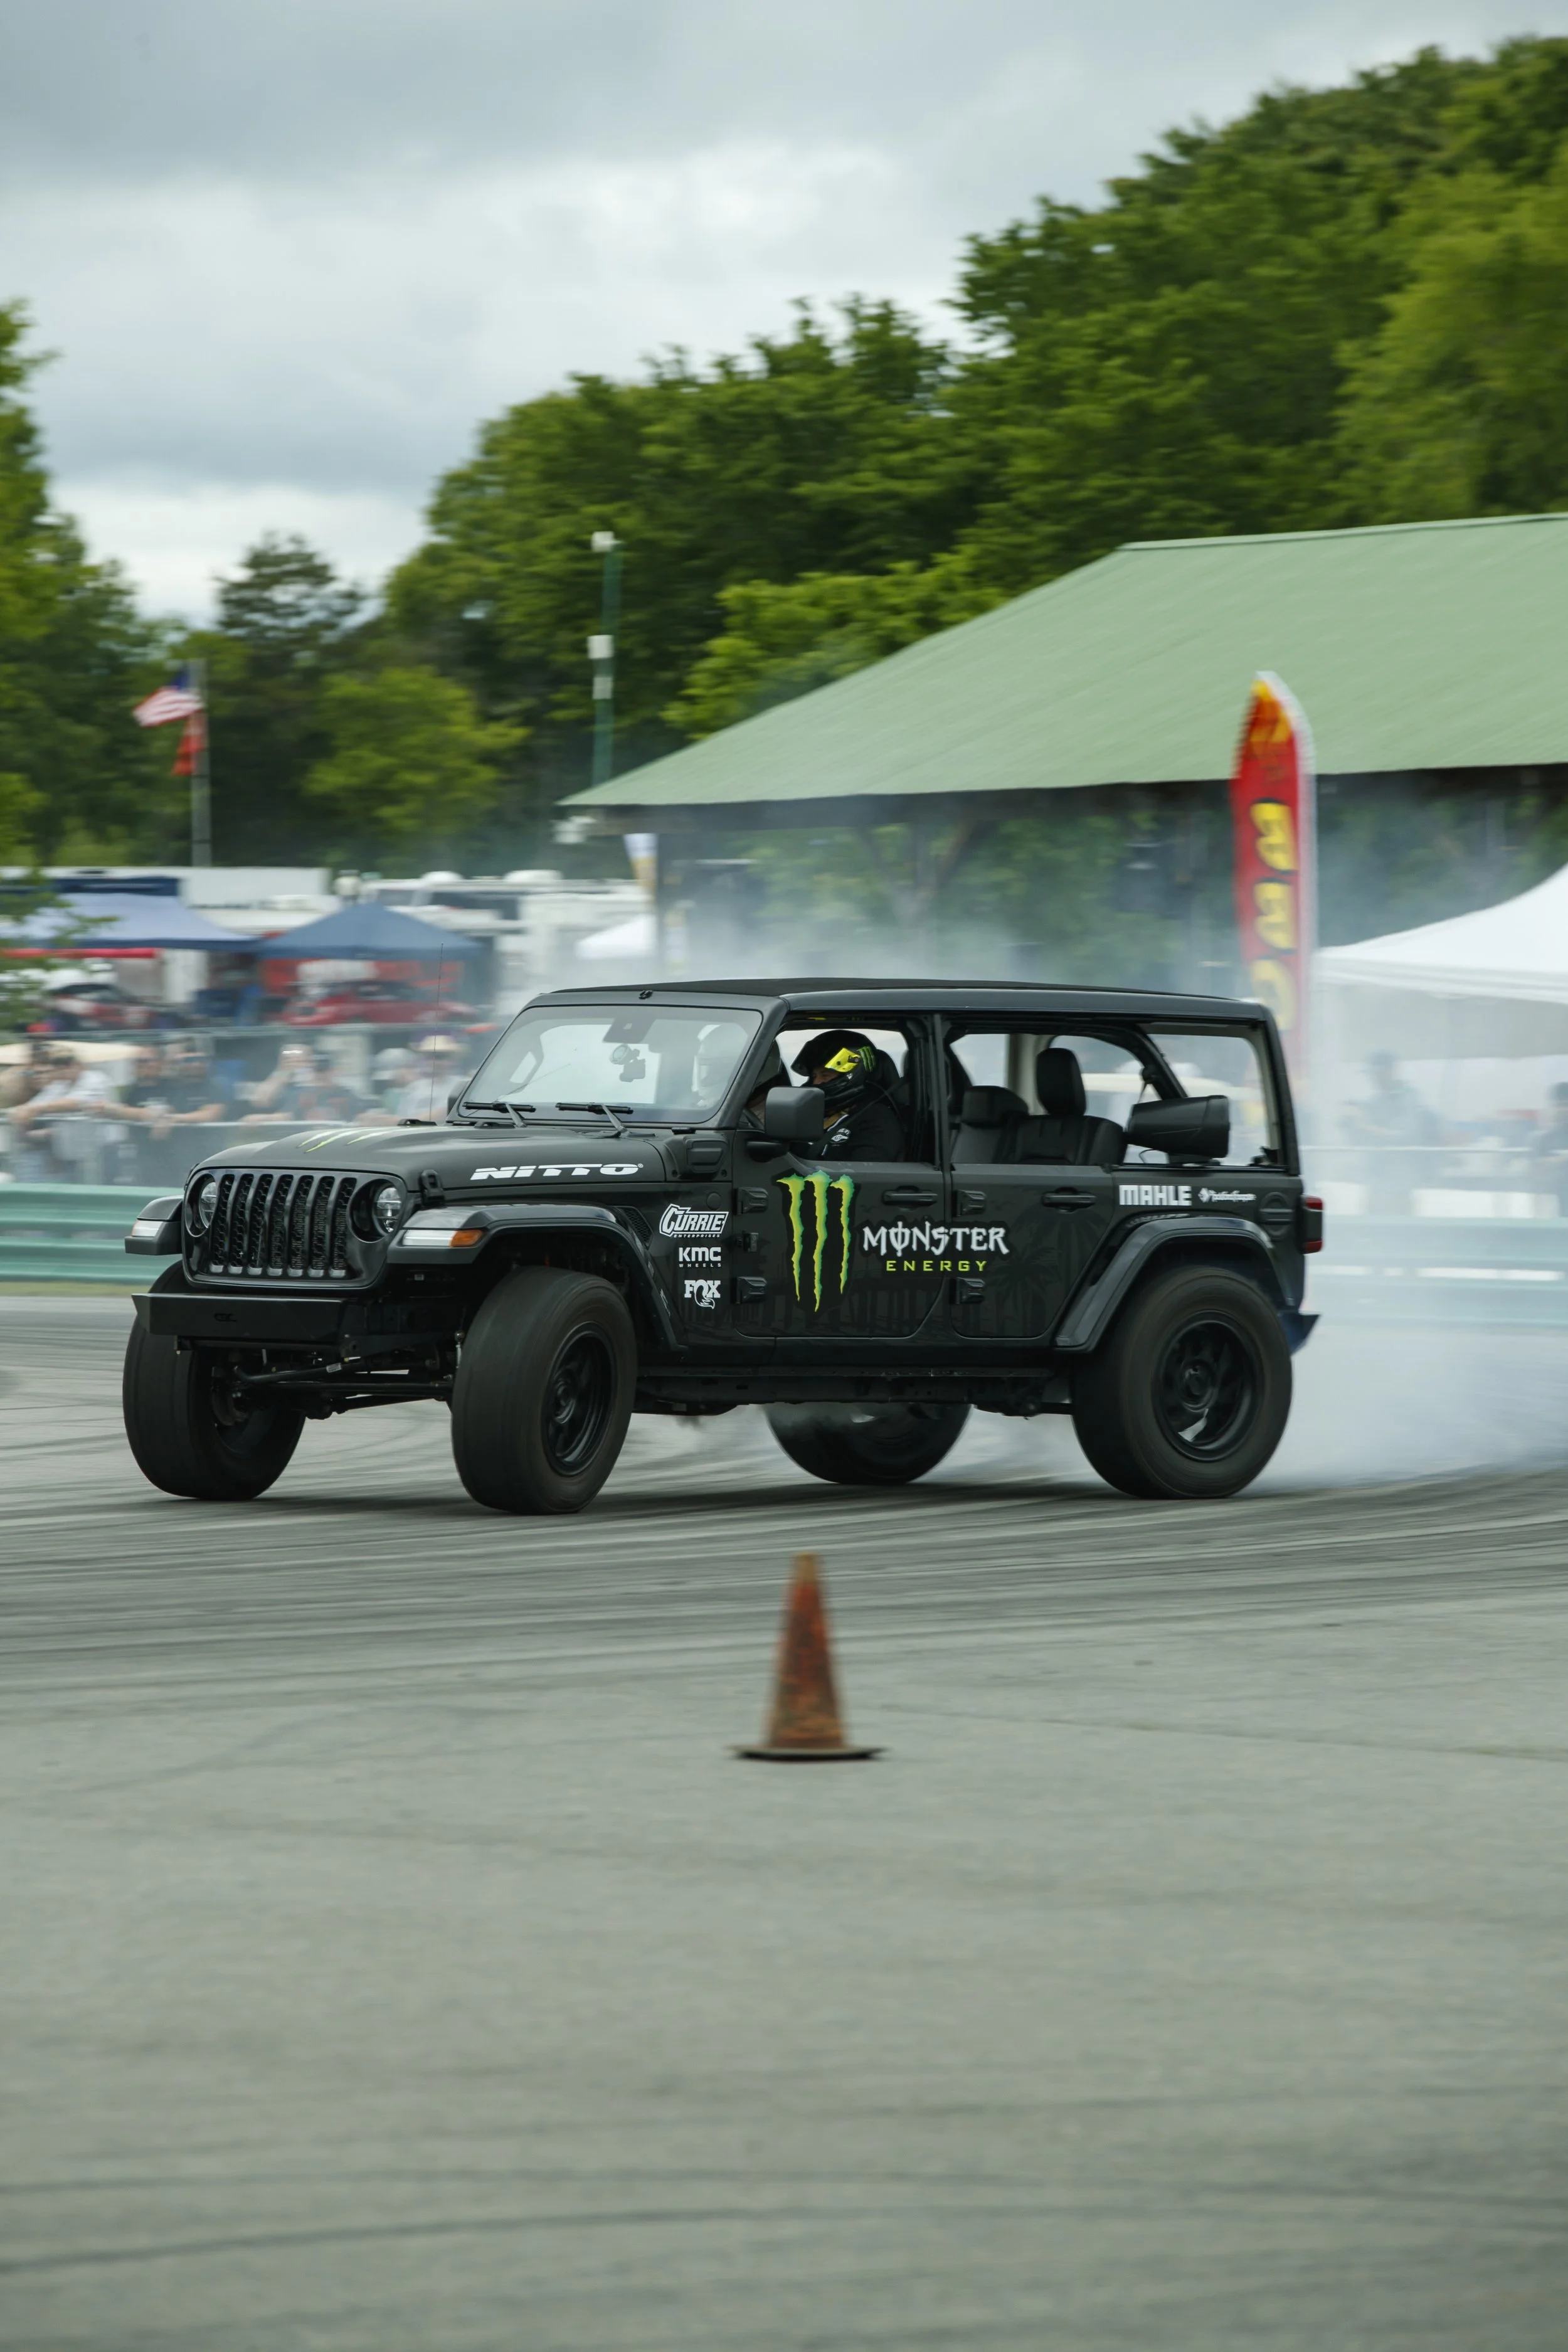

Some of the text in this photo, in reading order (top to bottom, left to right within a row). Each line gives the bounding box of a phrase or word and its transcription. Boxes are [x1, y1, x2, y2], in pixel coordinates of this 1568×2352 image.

[470, 1163, 640, 1180] NITTO
[1119, 1185, 1192, 1205] MAHLE
[662, 1207, 726, 1234] CURRIE
[862, 1221, 1009, 1256] MONSTER
[679, 1247, 721, 1261] KMC
[886, 1260, 988, 1272] ENERGY
[684, 1279, 721, 1309] FOX
